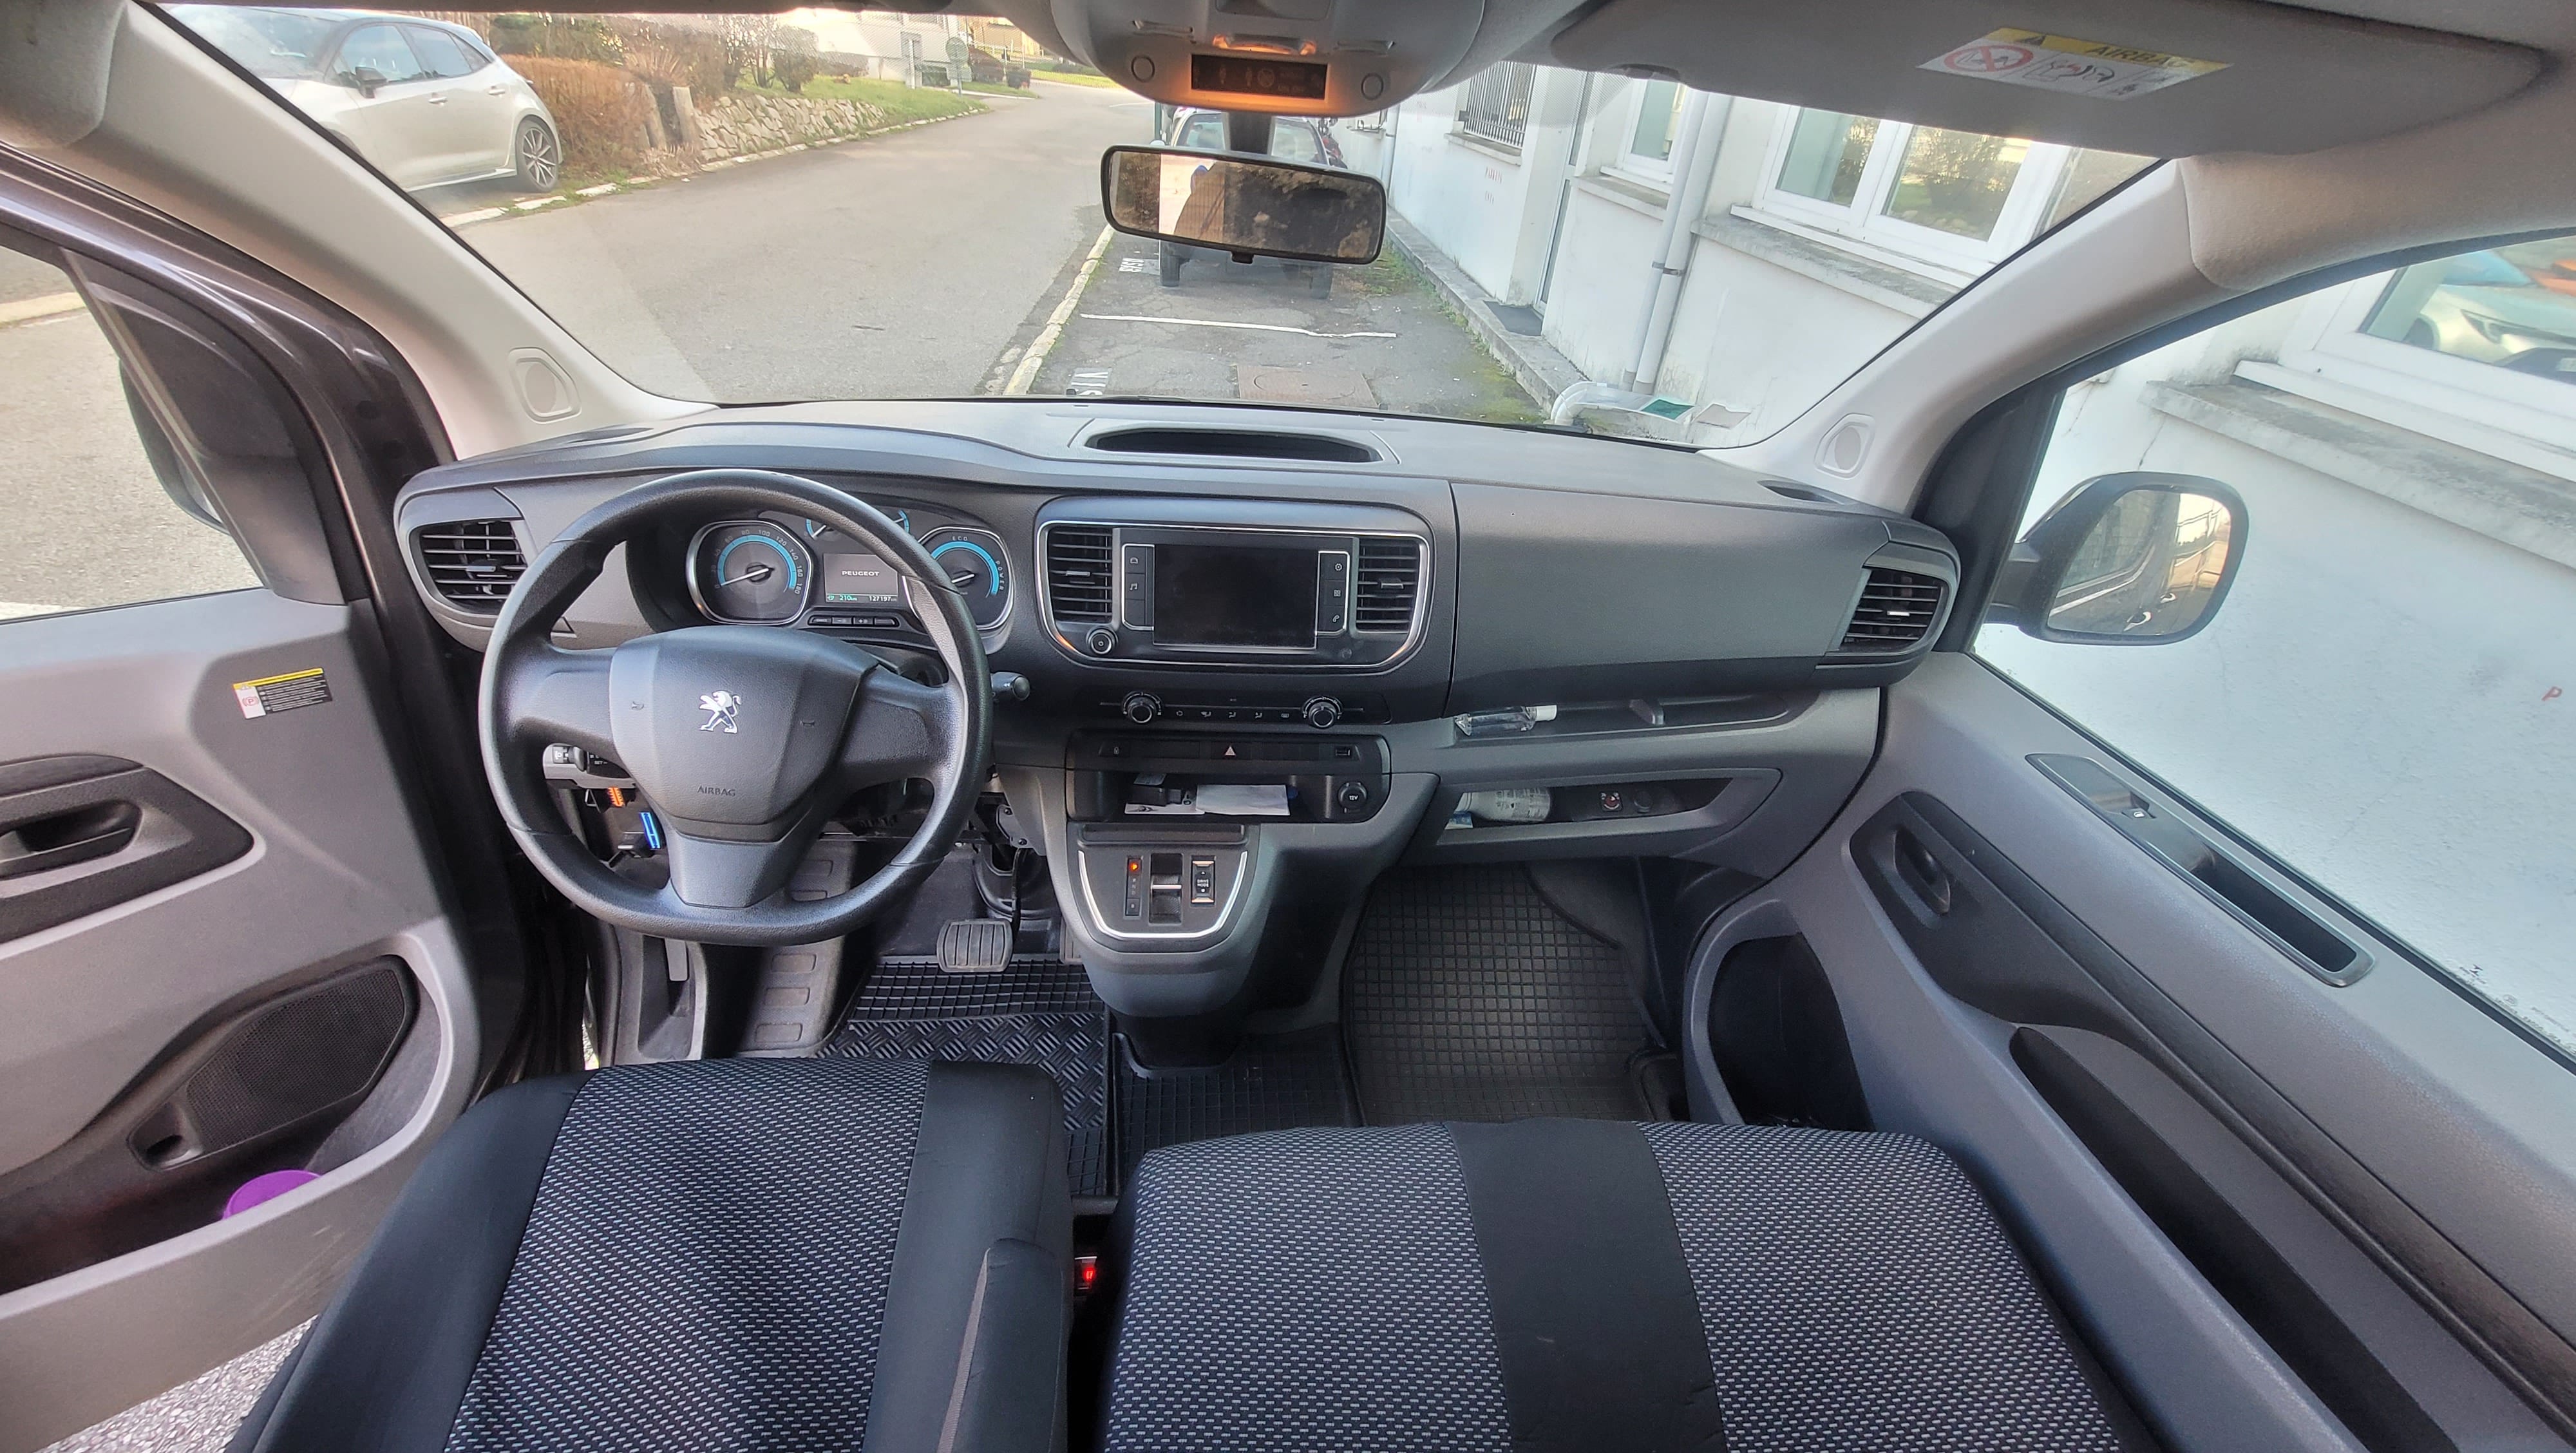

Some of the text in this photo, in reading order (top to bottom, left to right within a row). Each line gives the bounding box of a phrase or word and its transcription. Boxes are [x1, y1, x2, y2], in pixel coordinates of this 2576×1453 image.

[776, 536, 787, 546] 120
[790, 549, 799, 561] 140
[995, 560, 1005, 591] POWER
[794, 583, 802, 594] 180
[697, 785, 735, 797] AIRBAG
